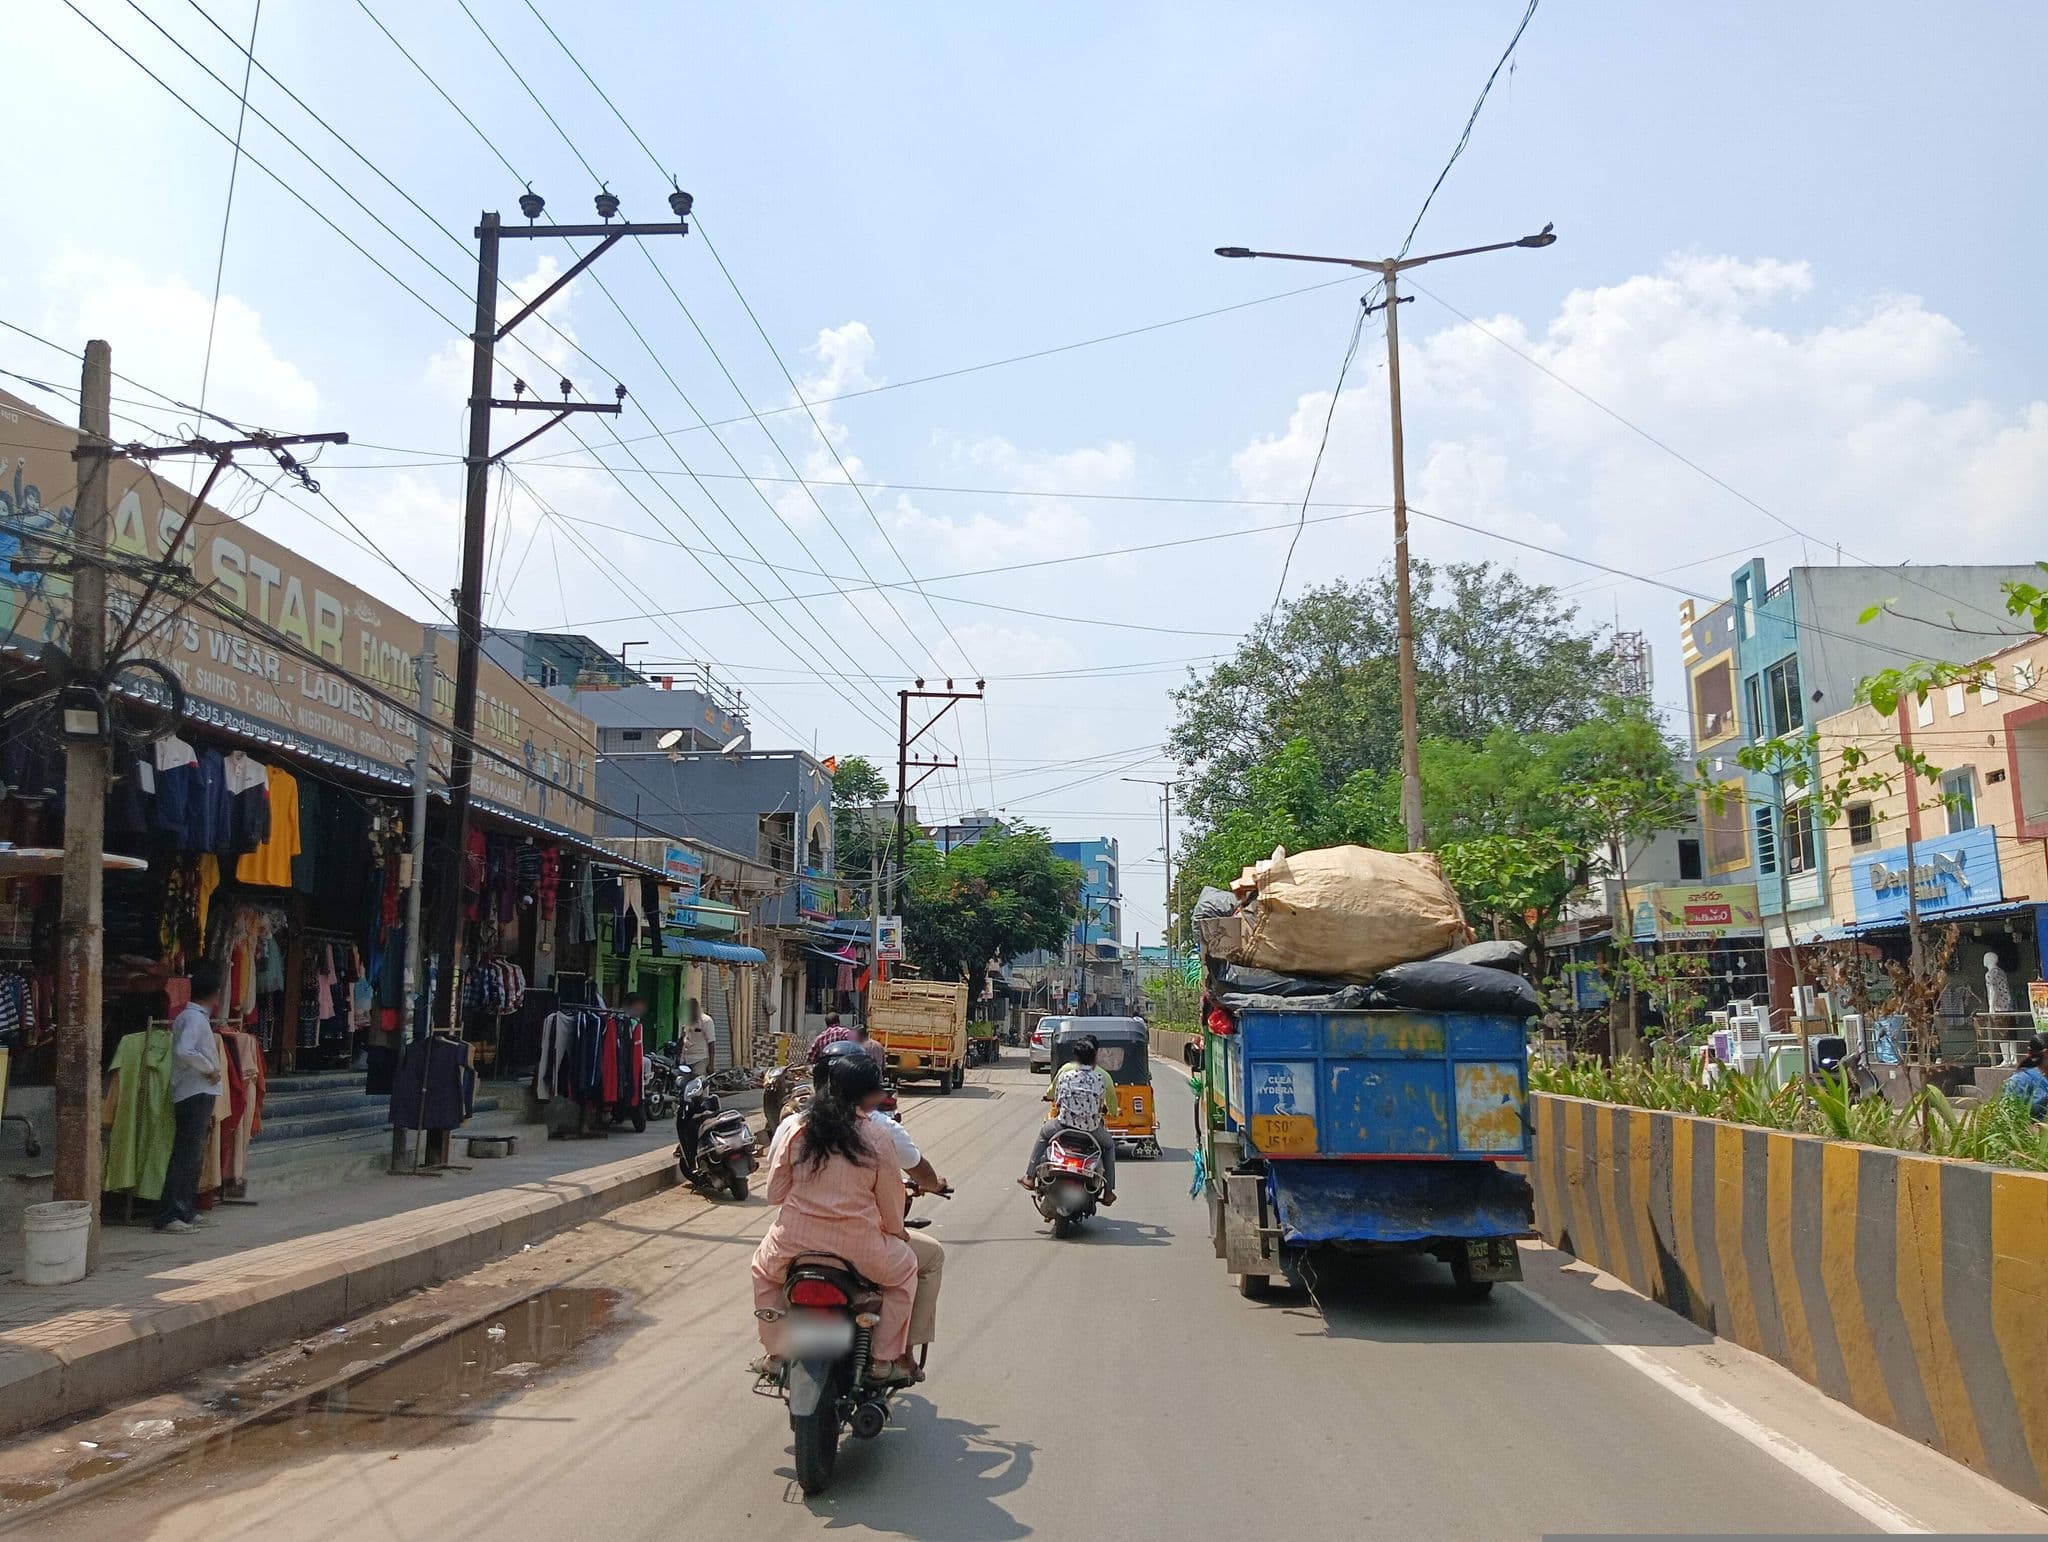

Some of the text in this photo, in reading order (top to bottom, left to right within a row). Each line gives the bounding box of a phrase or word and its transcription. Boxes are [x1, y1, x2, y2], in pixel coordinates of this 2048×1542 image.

[208, 535, 345, 668] STAR
[207, 629, 281, 687] WEAR
[300, 664, 374, 724] LADIES
[378, 701, 419, 742] WEA
[359, 629, 420, 705] FACTO
[490, 696, 520, 748] SALE
